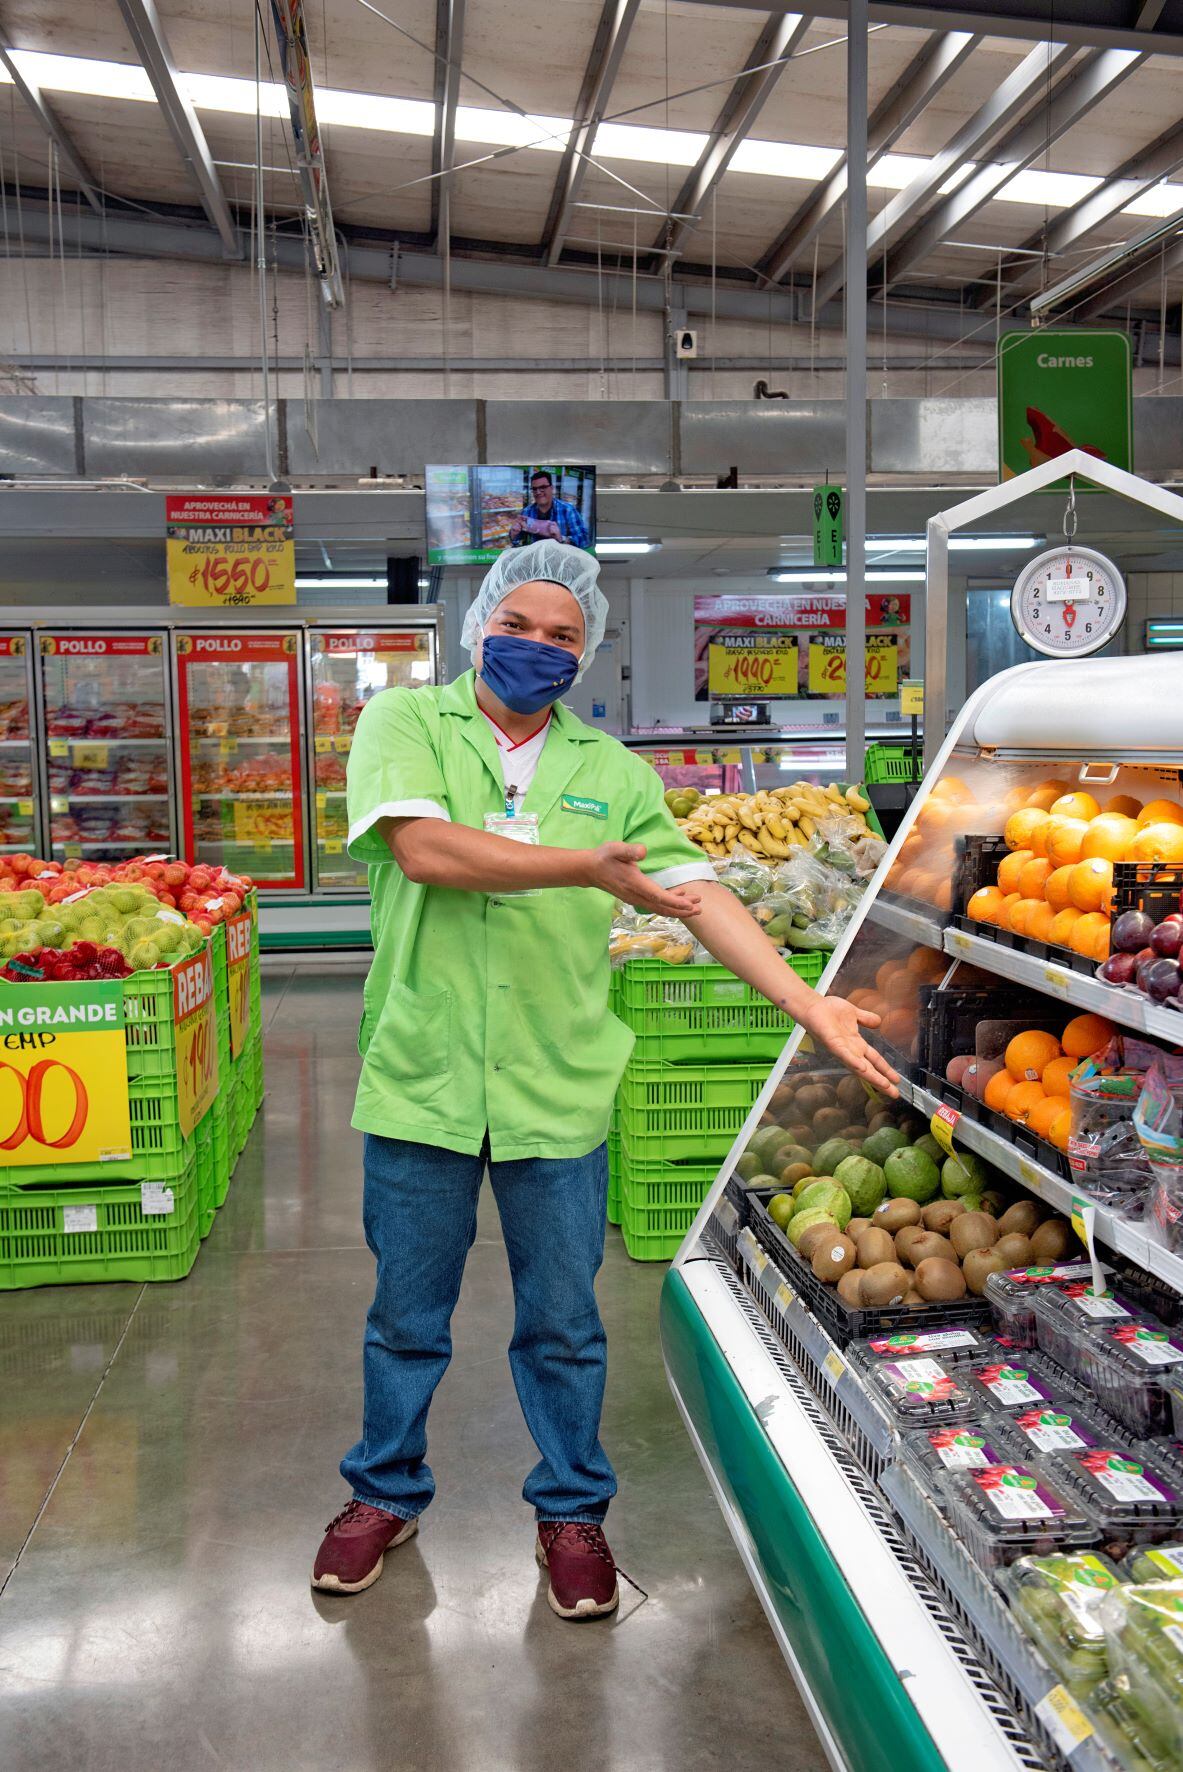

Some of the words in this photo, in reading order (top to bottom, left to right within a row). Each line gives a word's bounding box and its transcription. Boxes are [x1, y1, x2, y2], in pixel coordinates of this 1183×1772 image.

[1036, 353, 1094, 368] Carnes
[184, 500, 238, 510] APROVECHÁ
[238, 502, 251, 510] EN
[171, 511, 211, 520] NUESTRA
[212, 510, 264, 520] CARNICERÍA
[188, 528, 231, 542] MAXI
[232, 527, 286, 542] BLACK
[831, 529, 838, 543] E
[832, 545, 837, 559] 1
[1046, 572, 1052, 581] 1
[1086, 571, 1094, 582] 9
[1033, 587, 1040, 599] 2
[1097, 585, 1105, 597] 8
[793, 598, 811, 610] EN
[1032, 608, 1040, 619] 3
[1097, 606, 1105, 617] 7
[755, 611, 831, 625] CARNICERÍA
[1044, 623, 1052, 634] 4
[1085, 622, 1092, 633] 6
[1064, 630, 1072, 641] 5
[59, 640, 106, 653] POLLO
[196, 638, 242, 651] POLLO
[329, 637, 374, 650] POLLO
[724, 637, 755, 647] MAXI
[755, 637, 794, 647] BLACK
[17, 1003, 118, 1026] GRANDE
[4, 1031, 56, 1050] EMP
